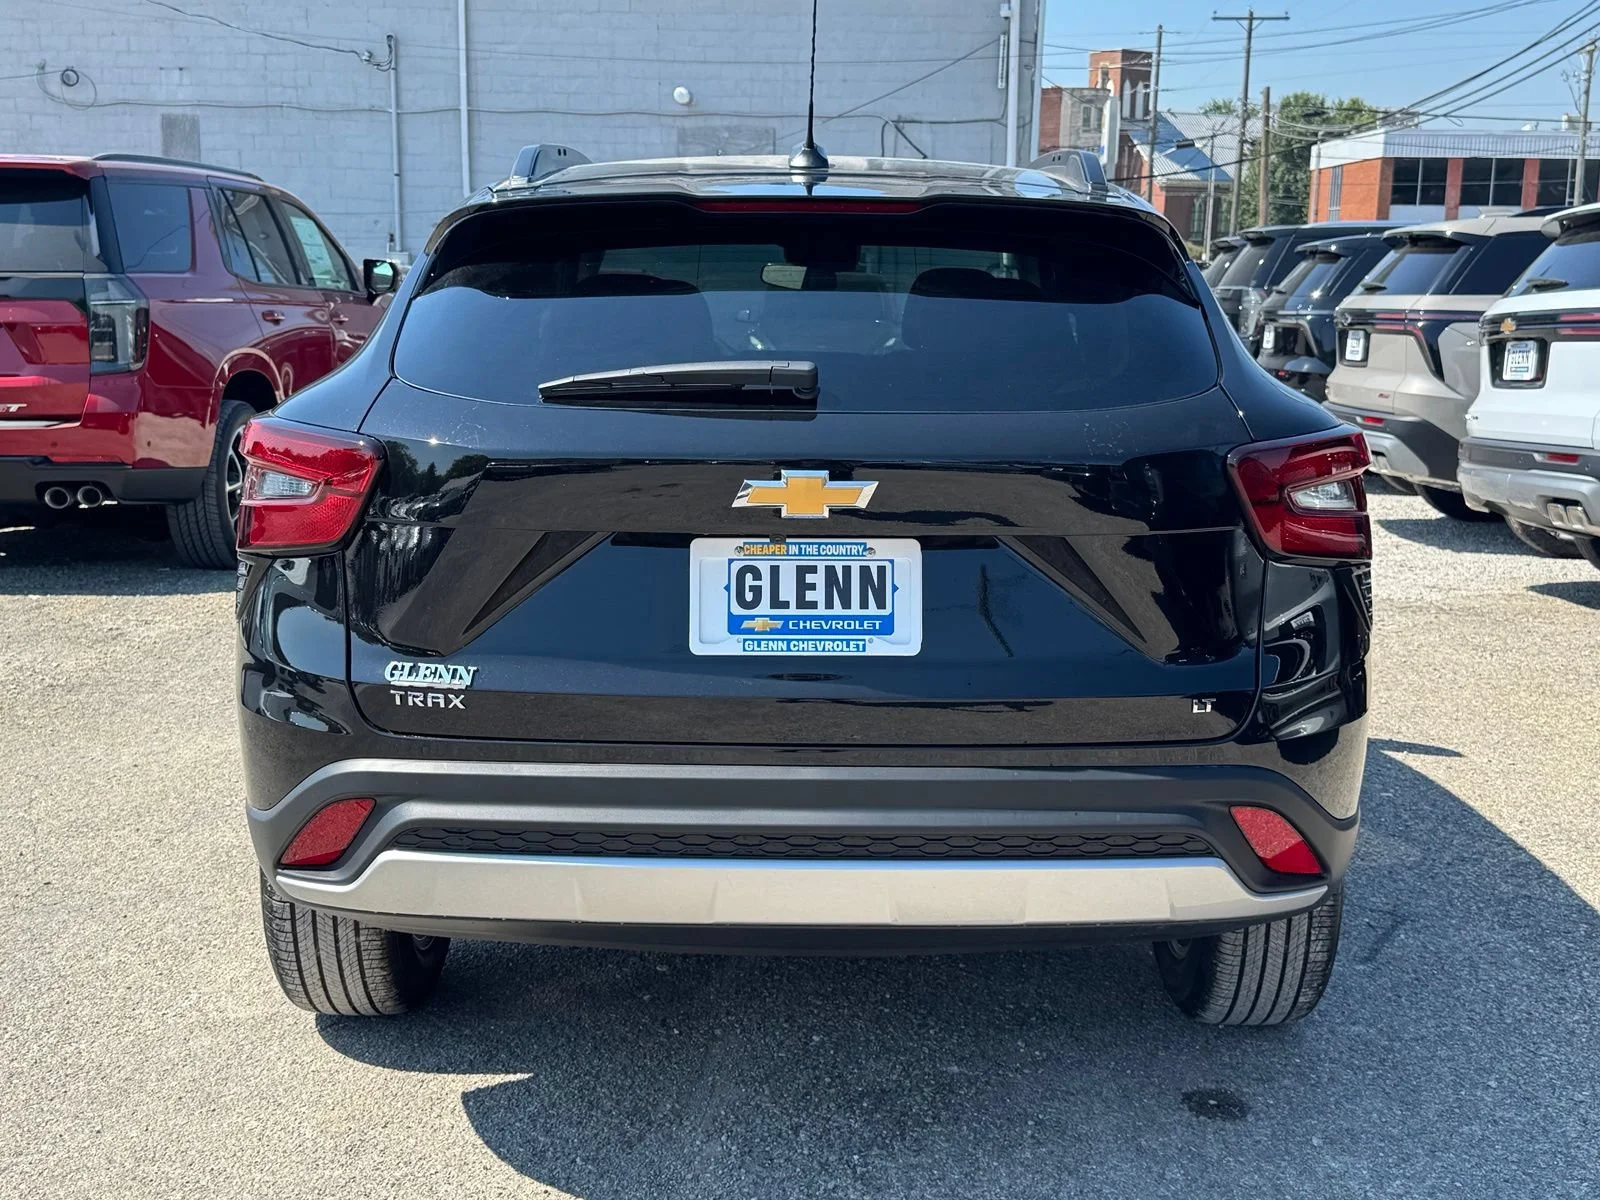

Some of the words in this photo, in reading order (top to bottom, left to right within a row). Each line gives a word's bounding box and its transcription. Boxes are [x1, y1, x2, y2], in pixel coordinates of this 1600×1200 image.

[743, 544, 787, 555] CHEAPER
[788, 544, 800, 555] IN
[801, 544, 818, 555] THE
[735, 564, 887, 610] GLENN
[788, 620, 883, 630] CHEVROLET
[744, 640, 787, 651] GLENN
[789, 640, 865, 652] CHEVROLET
[384, 660, 478, 686] GLENN
[389, 689, 466, 709] TRAX
[1192, 698, 1217, 714] LT
